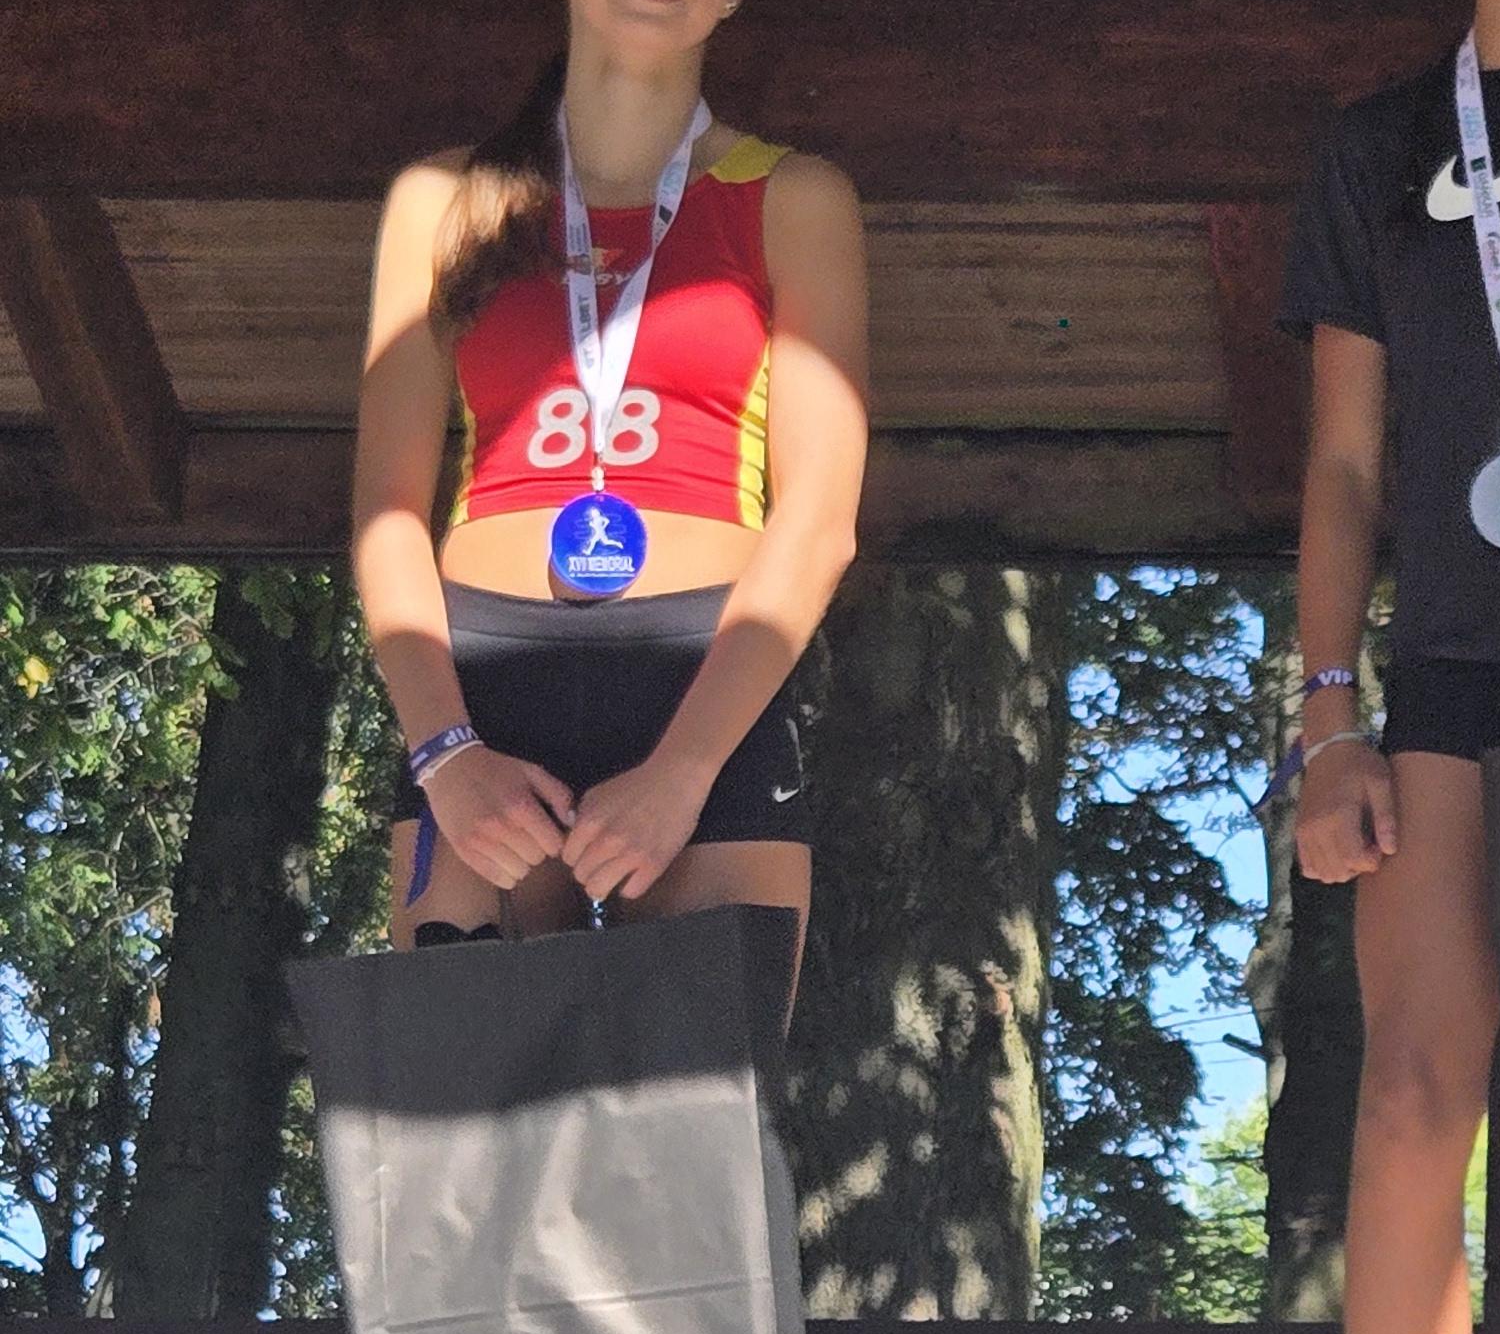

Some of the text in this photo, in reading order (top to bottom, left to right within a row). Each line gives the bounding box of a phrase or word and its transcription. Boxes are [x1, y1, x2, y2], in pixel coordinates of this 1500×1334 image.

[528, 388, 661, 469] 88
[1317, 669, 1353, 686] VIP
[444, 725, 480, 747] VIP
